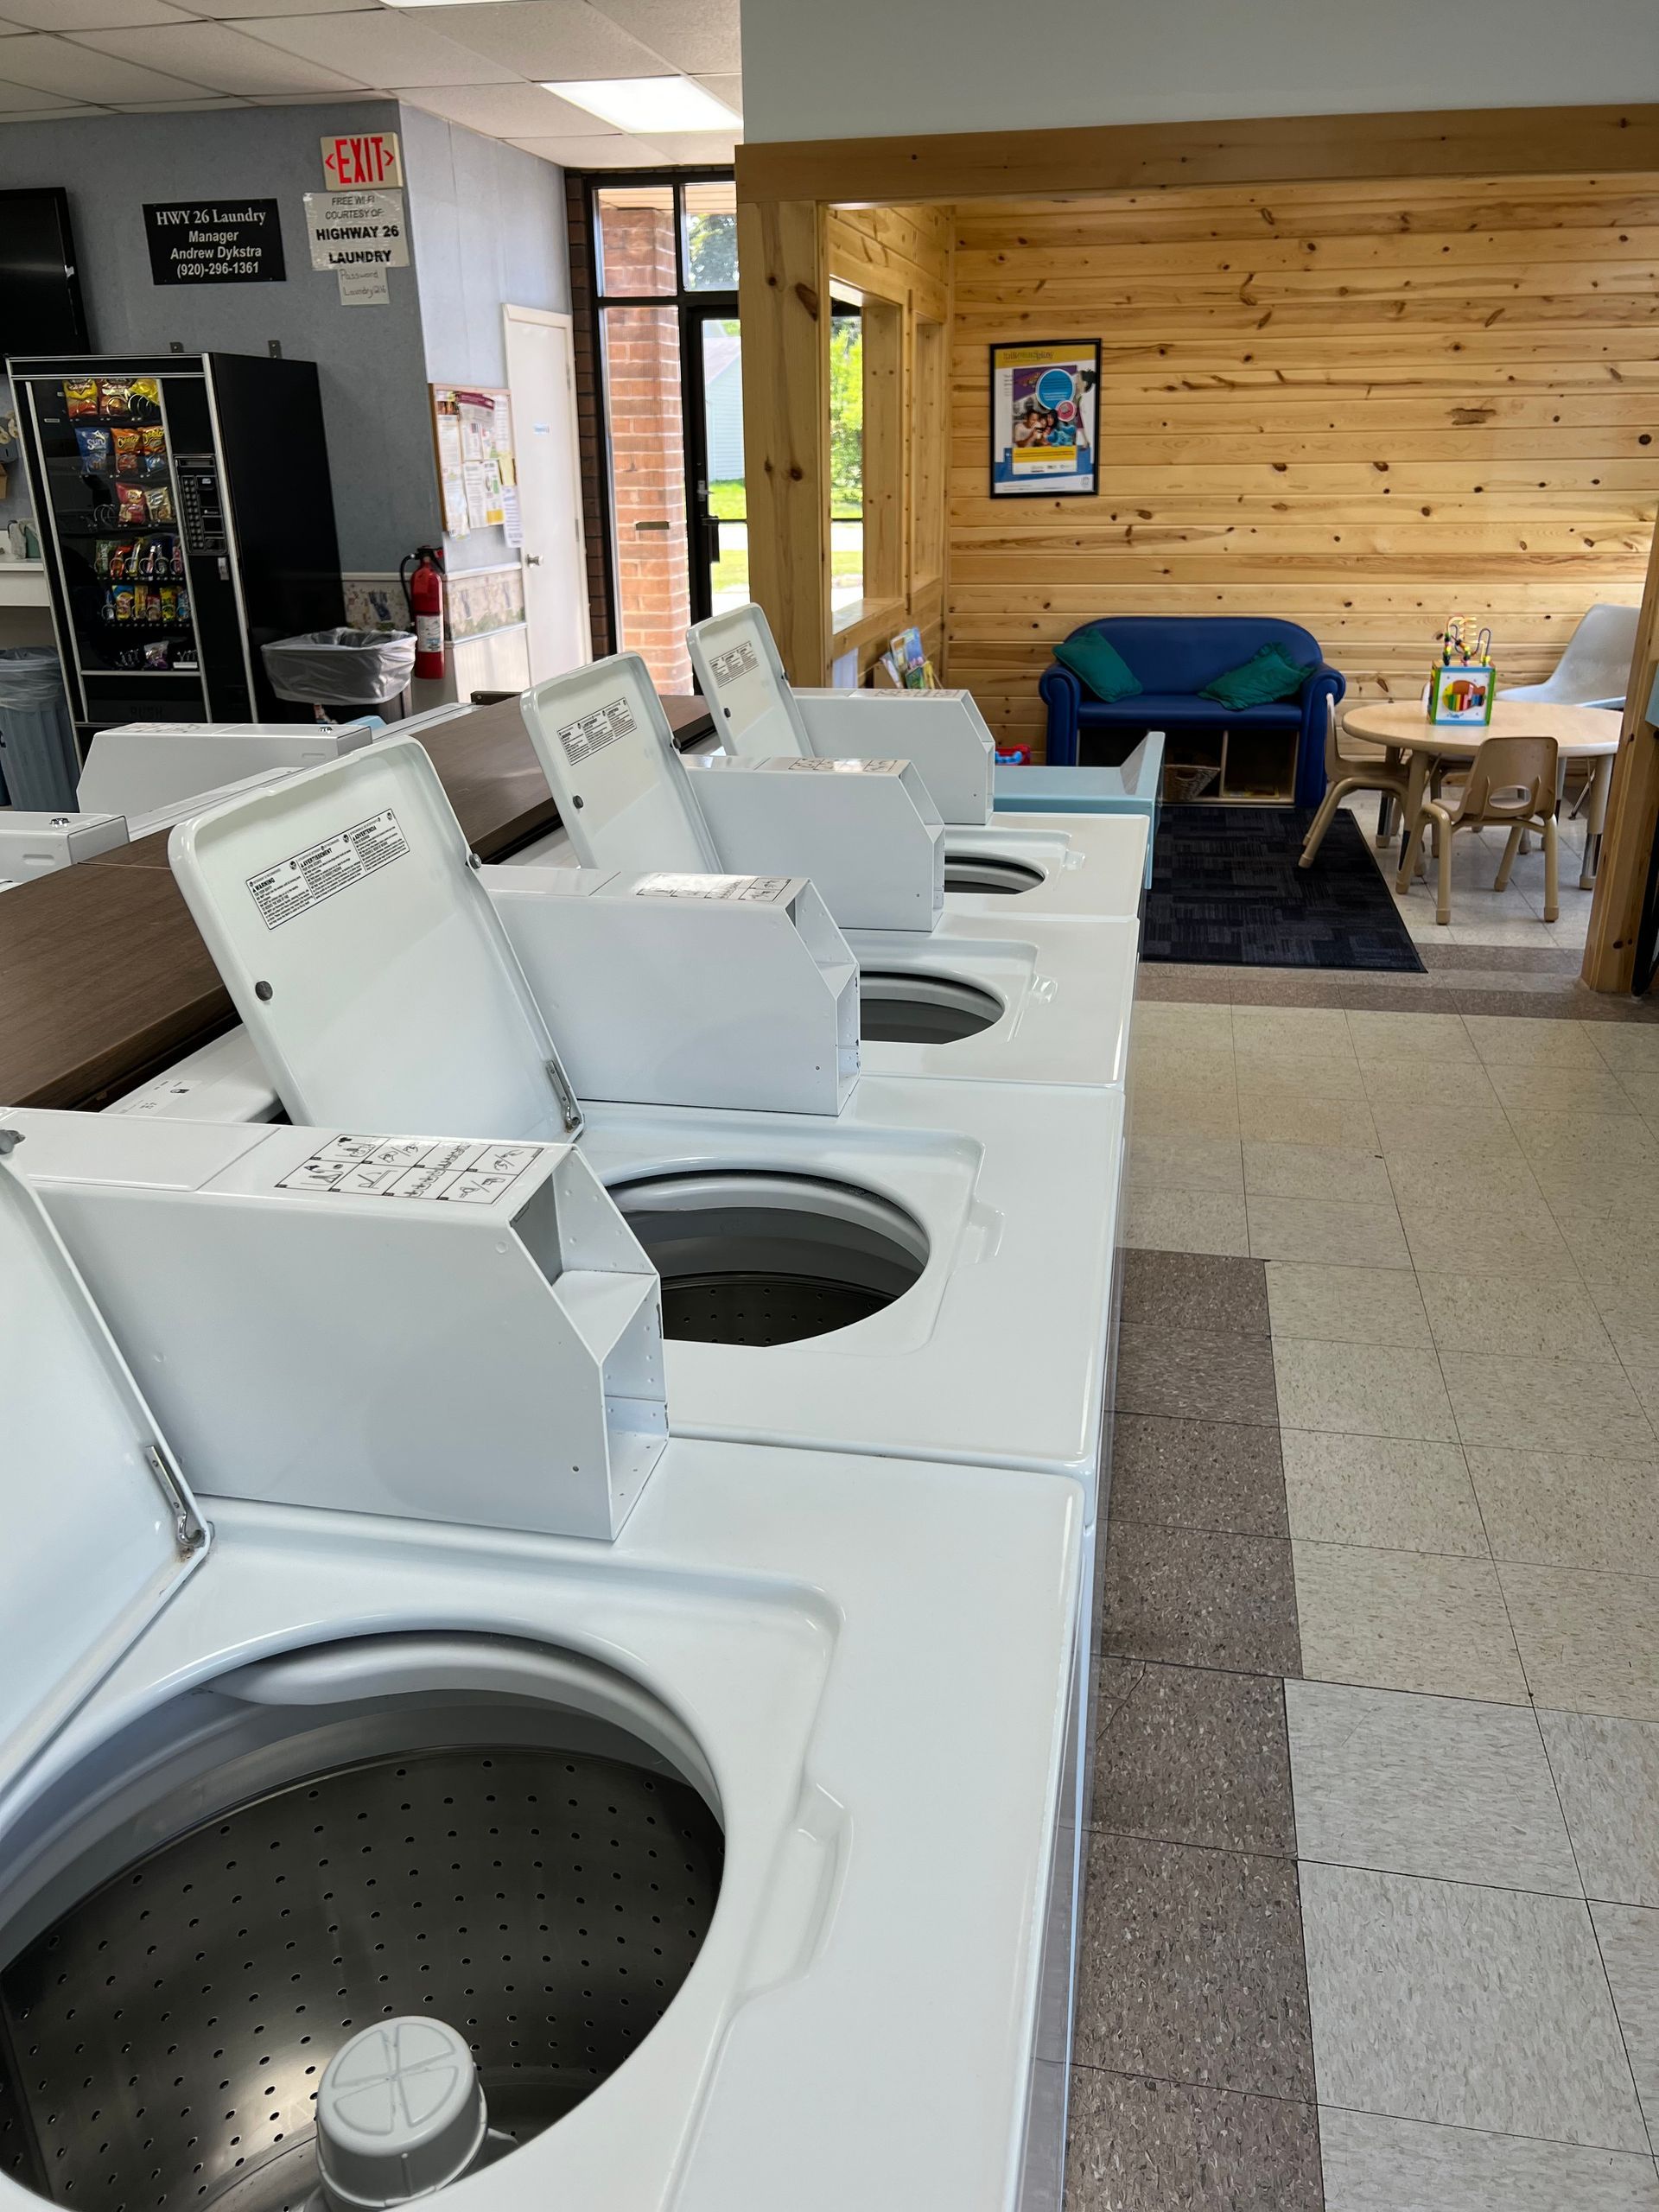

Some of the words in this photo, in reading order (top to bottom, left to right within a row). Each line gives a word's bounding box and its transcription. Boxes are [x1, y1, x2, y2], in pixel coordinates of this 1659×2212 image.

[334, 137, 385, 184] EXIT
[331, 196, 353, 206] FREE
[156, 210, 191, 226] HWY
[193, 208, 210, 224] 26
[212, 207, 266, 226] Laundry
[325, 209, 370, 219] COURTESY
[370, 208, 385, 218] OF
[188, 230, 239, 245] Manager
[315, 226, 378, 241] HIGHWAY
[382, 225, 399, 238] 26
[170, 247, 214, 259] Andrew
[217, 245, 263, 261] Dykstra
[328, 250, 392, 264] LAUNDRY
[176, 261, 259, 279] (920)-296-1361
[255, 877, 276, 891] WARNING
